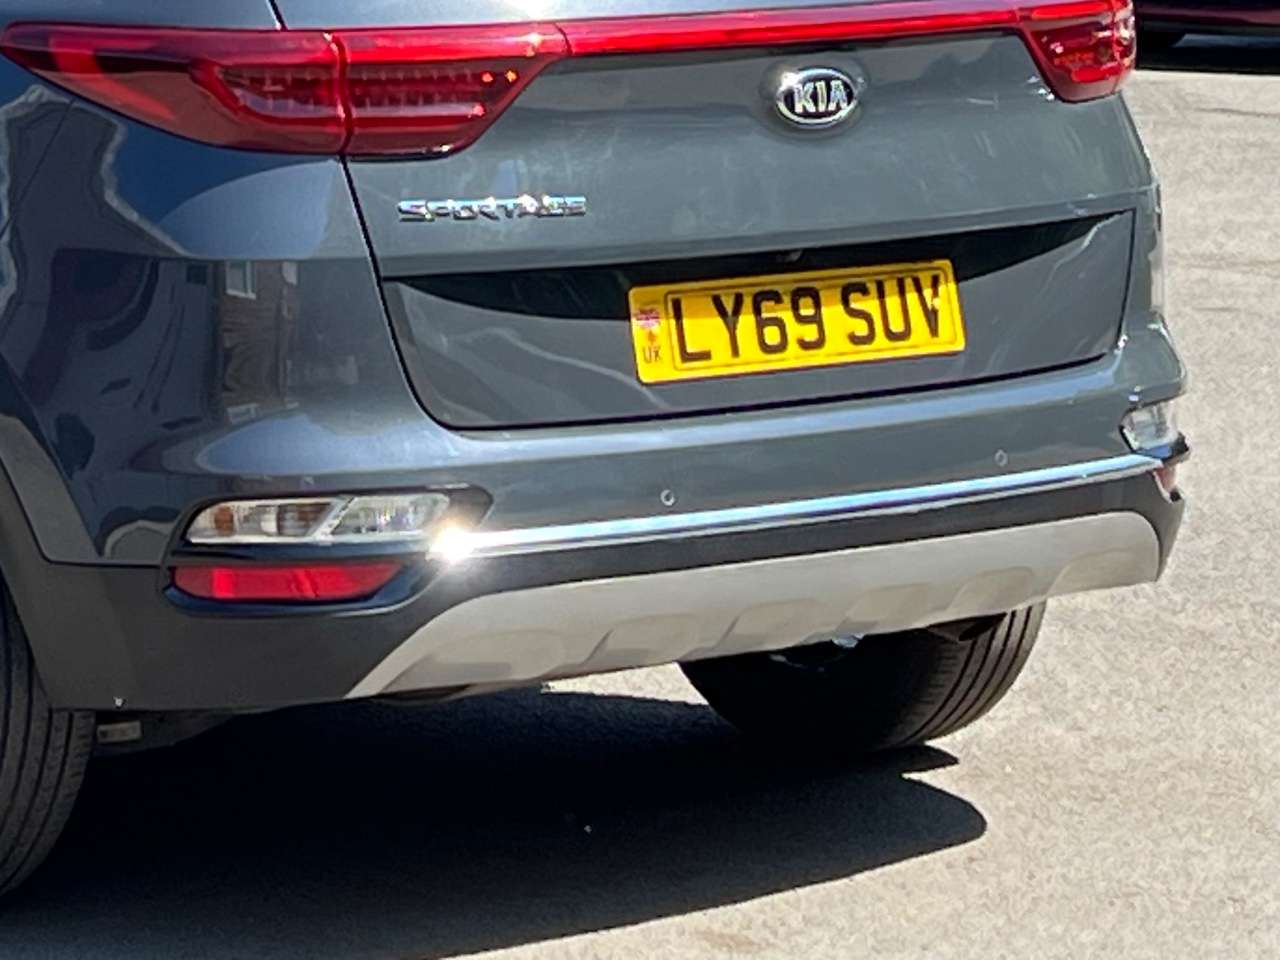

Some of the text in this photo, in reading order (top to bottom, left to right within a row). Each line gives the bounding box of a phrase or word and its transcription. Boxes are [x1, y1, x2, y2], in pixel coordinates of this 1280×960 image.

[793, 79, 849, 114] KIA
[671, 274, 941, 364] LY69 SUV
